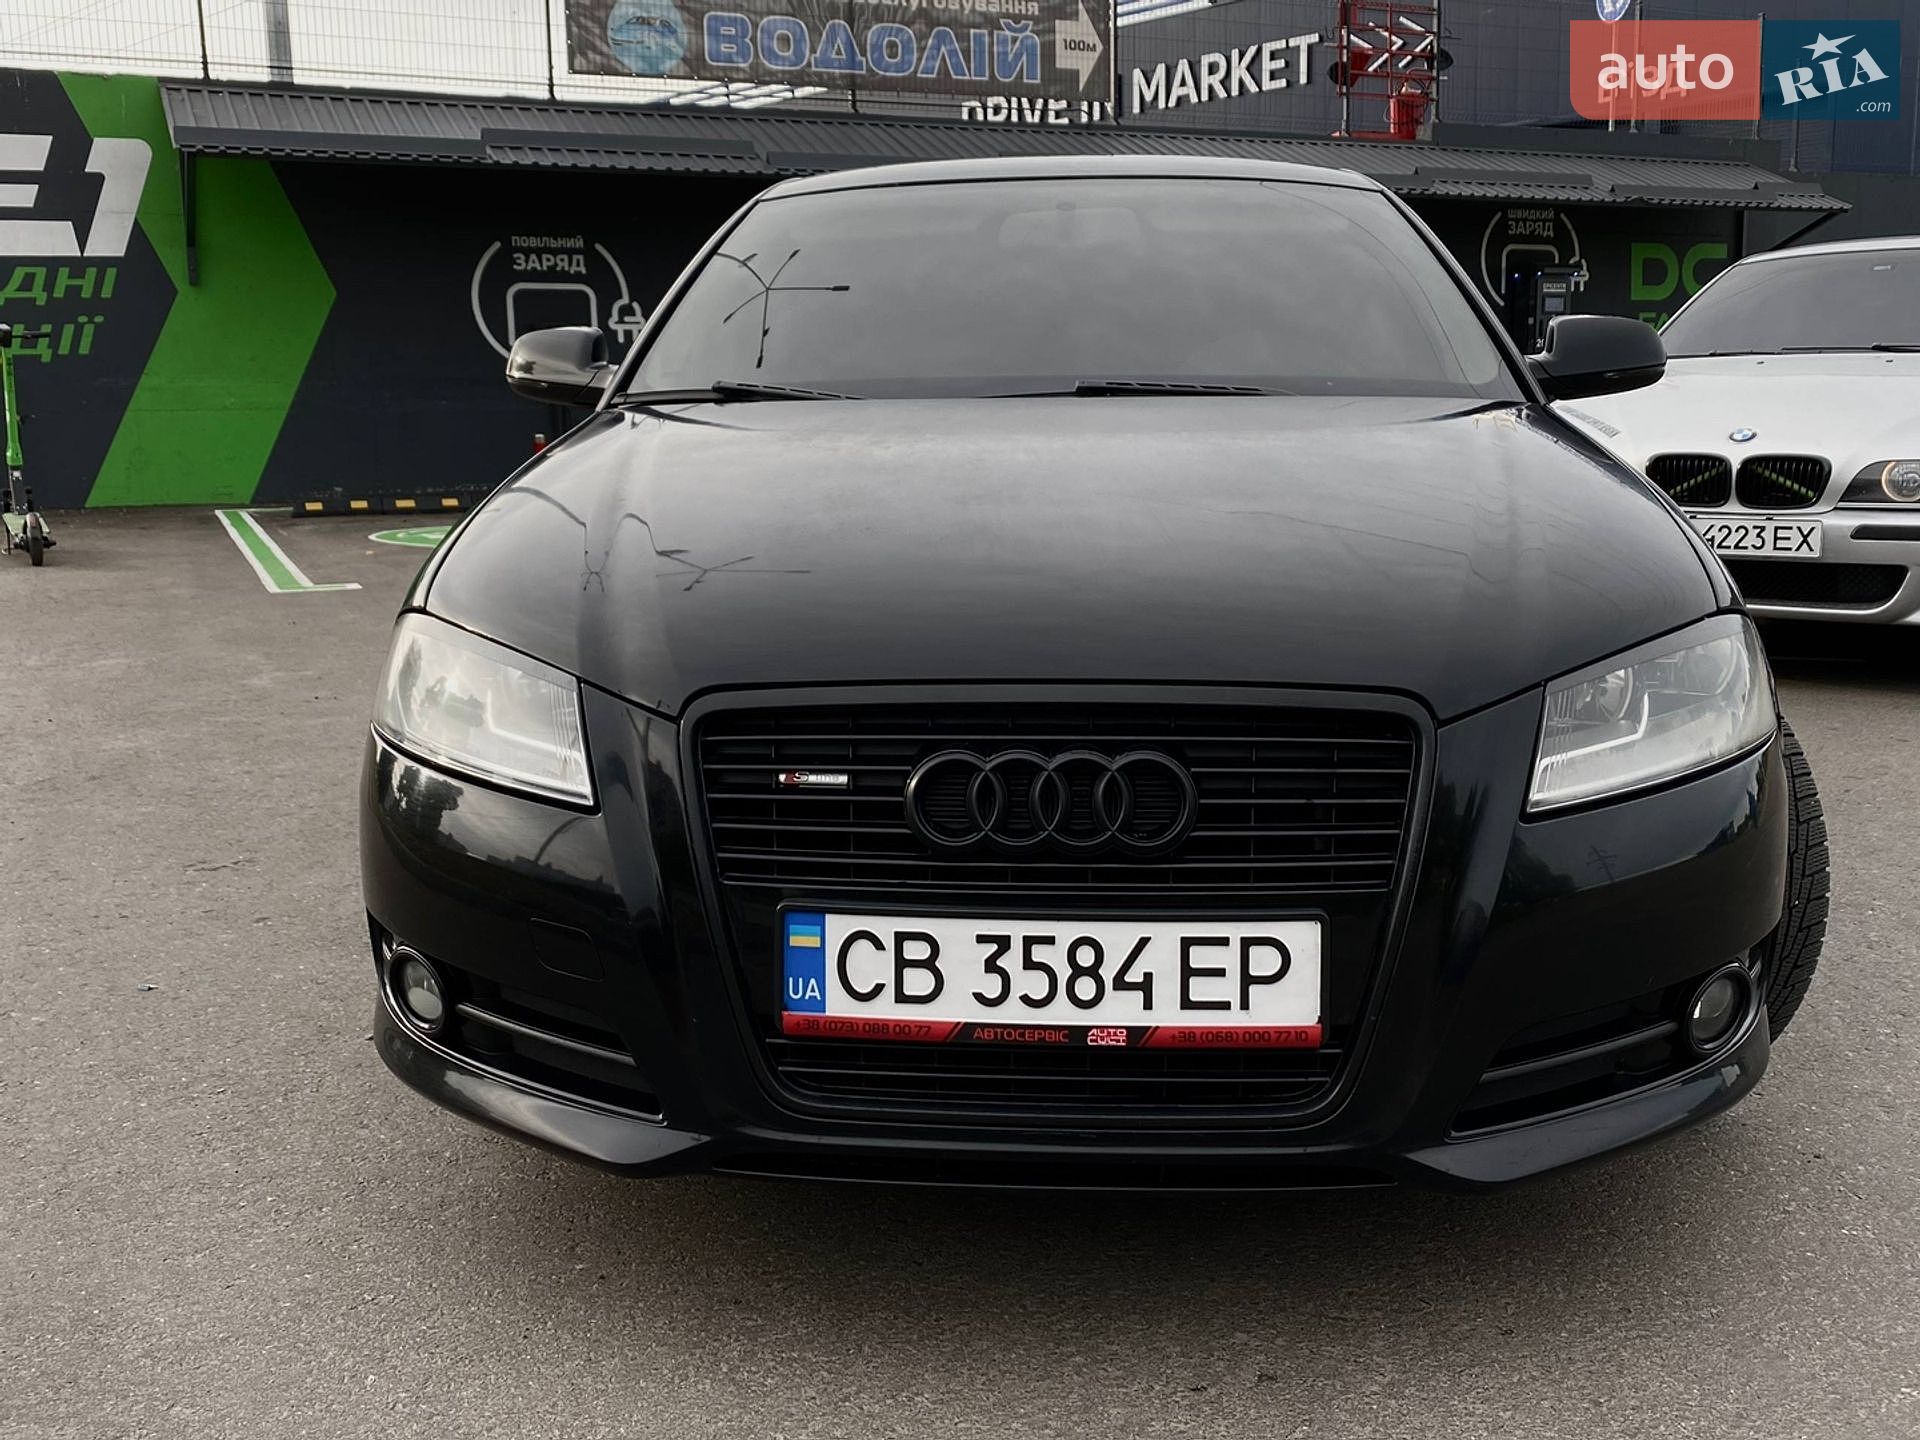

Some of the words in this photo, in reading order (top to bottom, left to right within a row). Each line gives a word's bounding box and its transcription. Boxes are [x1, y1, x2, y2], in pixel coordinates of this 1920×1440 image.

[702, 11, 1042, 84] ВОДОЛІЙ
[1132, 32, 1320, 114] MARKET
[1508, 220, 1555, 238] ЗАРЯД
[511, 235, 584, 248] ПОВІЛЬНИЙ
[512, 253, 587, 274] ЗАРЯД
[1631, 243, 1728, 300] DC
[1772, 526, 1816, 552] EX
[836, 929, 944, 1005] CB
[971, 934, 1154, 1011] 3584
[1179, 936, 1292, 1011] EP
[789, 978, 821, 1001] UA
[862, 1022, 891, 1034] 088
[892, 1024, 912, 1035] 00
[914, 1025, 931, 1037] 77
[973, 1028, 1070, 1042] АВТОСЕРВІС
[1170, 1031, 1197, 1043] +38
[1200, 1031, 1240, 1044] (068)
[1242, 1031, 1271, 1042] 000
[1274, 1031, 1291, 1042] 77
[1293, 1030, 1309, 1042] 10
